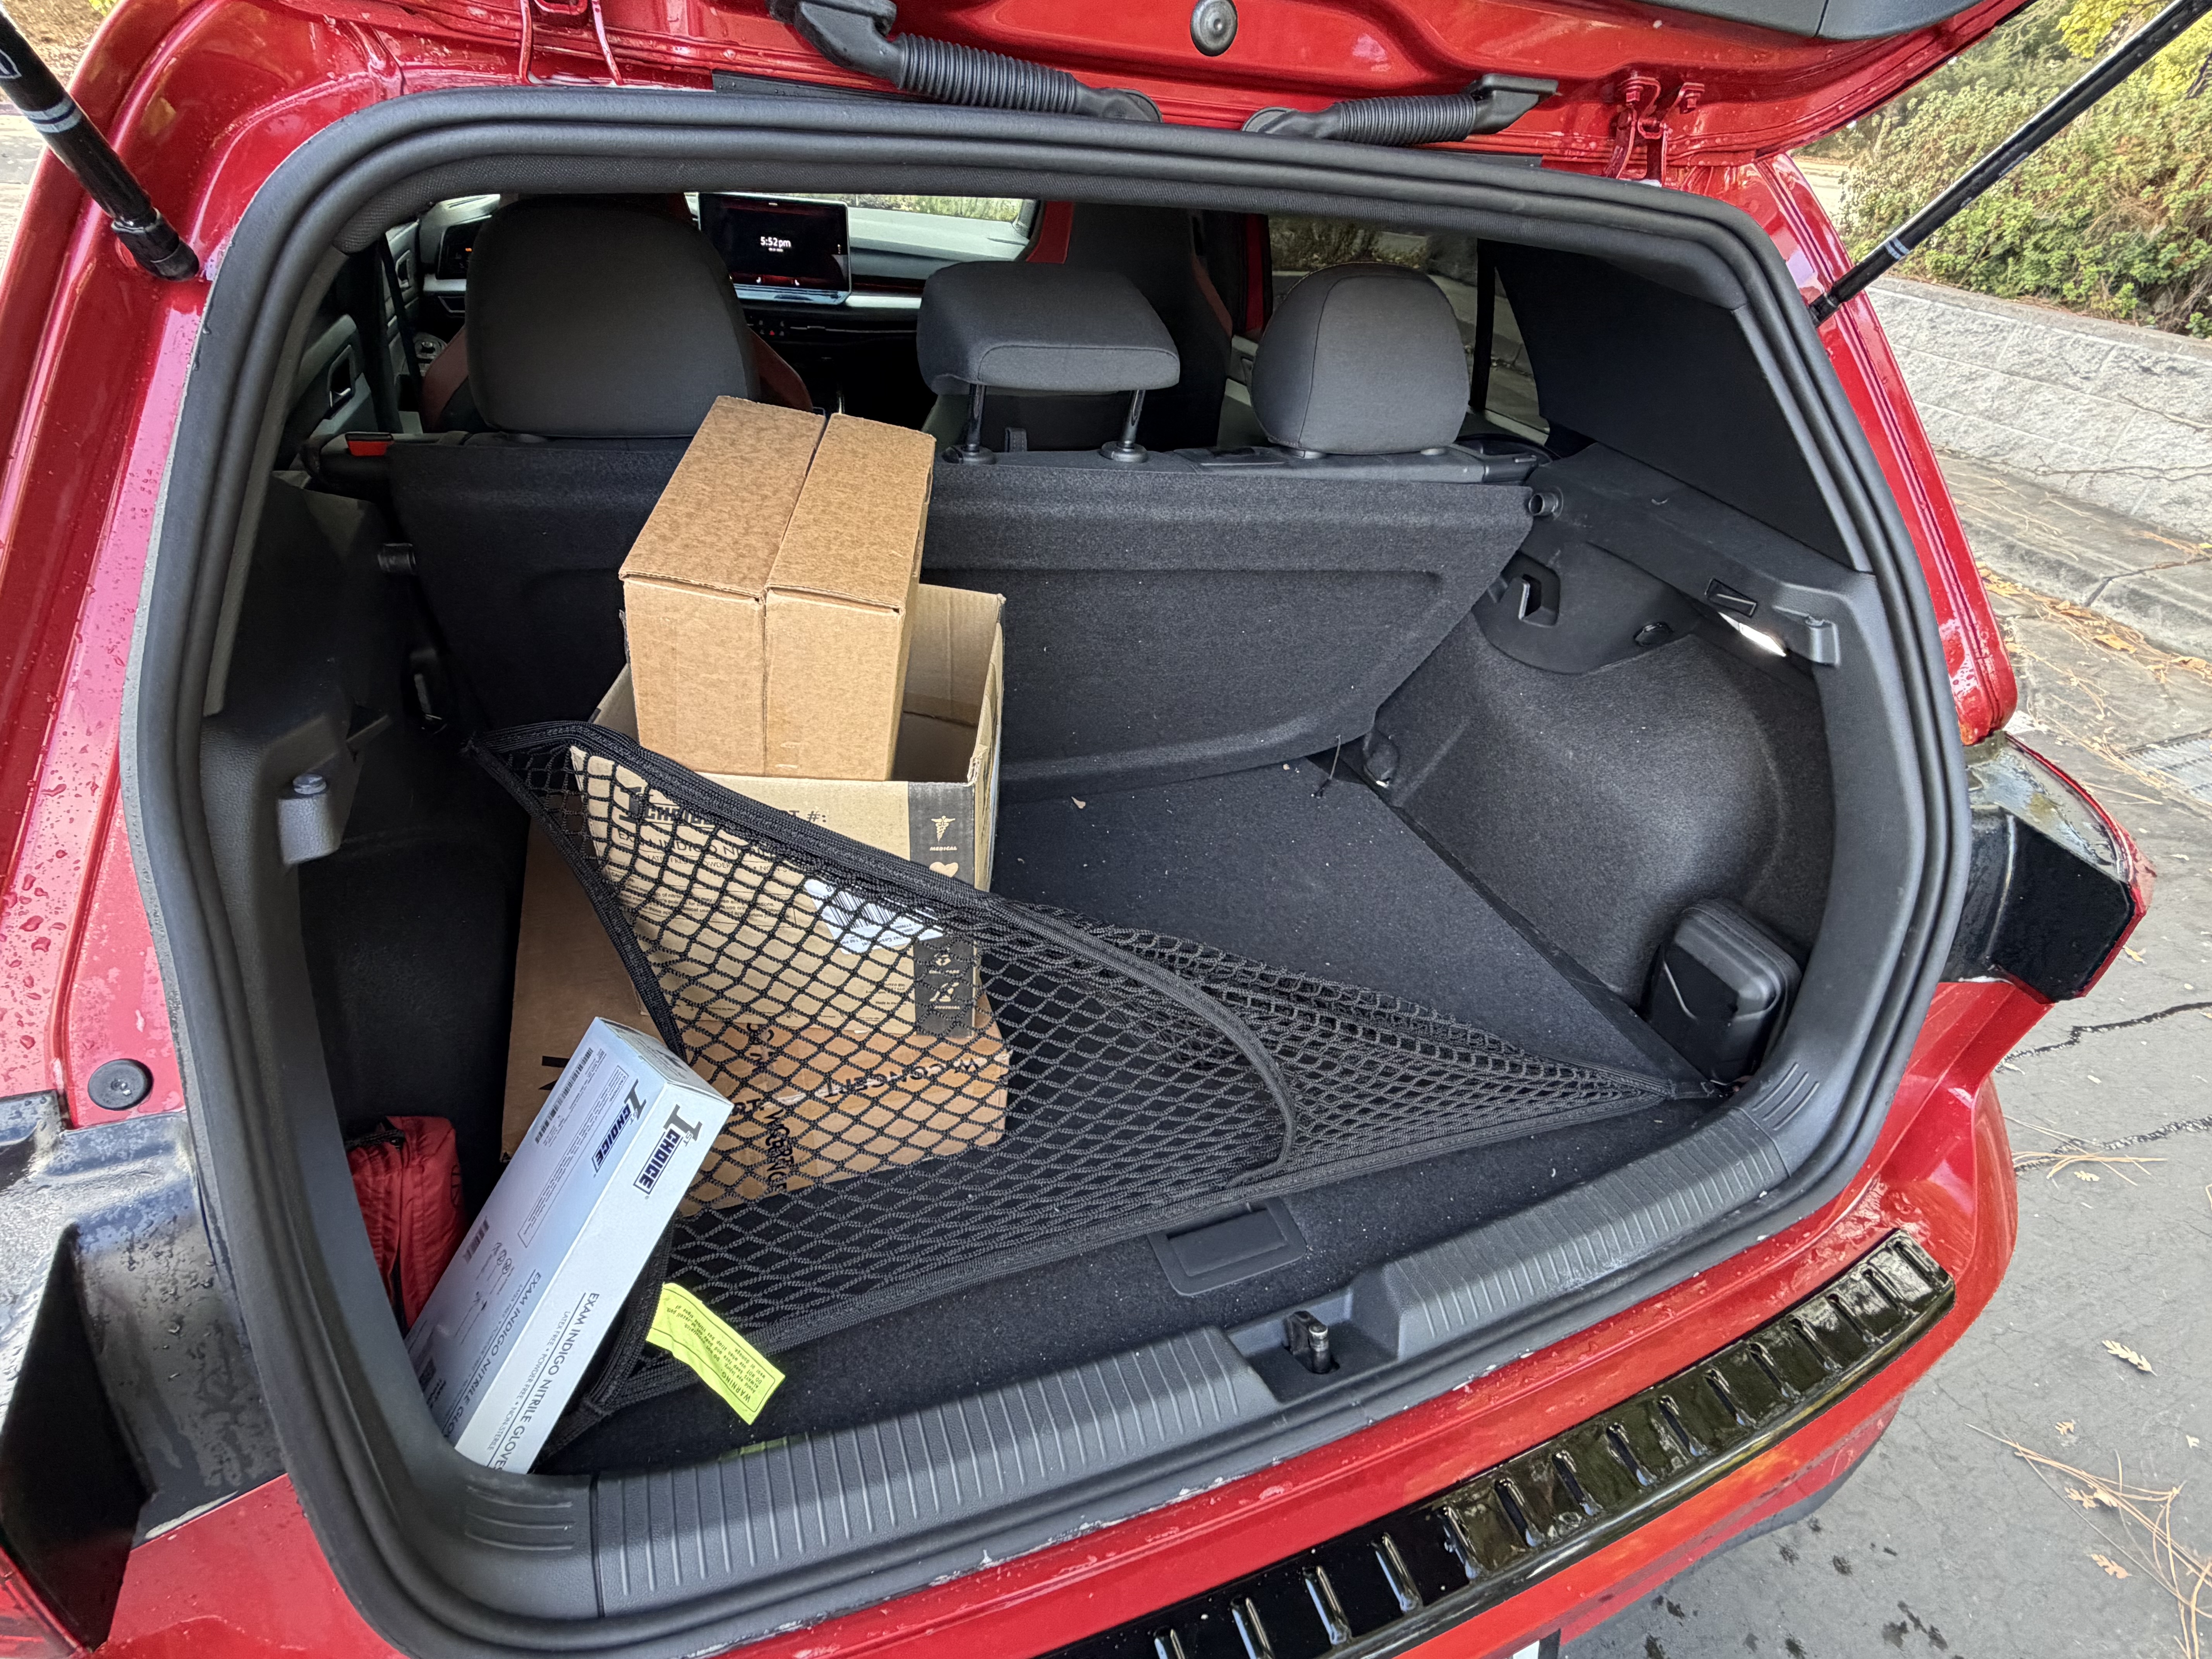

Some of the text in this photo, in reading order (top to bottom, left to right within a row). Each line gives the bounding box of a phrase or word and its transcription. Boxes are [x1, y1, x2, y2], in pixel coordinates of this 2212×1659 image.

[594, 1103, 631, 1166] CHOICE
[638, 1128, 681, 1189] CHOICE
[519, 1271, 541, 1305] EXAM
[574, 1293, 599, 1326] EXAM
[489, 1307, 521, 1357] INDIGO
[546, 1330, 560, 1346] FREE
[556, 1311, 571, 1330] LATEX
[547, 1328, 580, 1377] INDIGO
[463, 1358, 491, 1405] NITRILE
[516, 1384, 530, 1400] FREE
[519, 1378, 552, 1422] NITRILE
